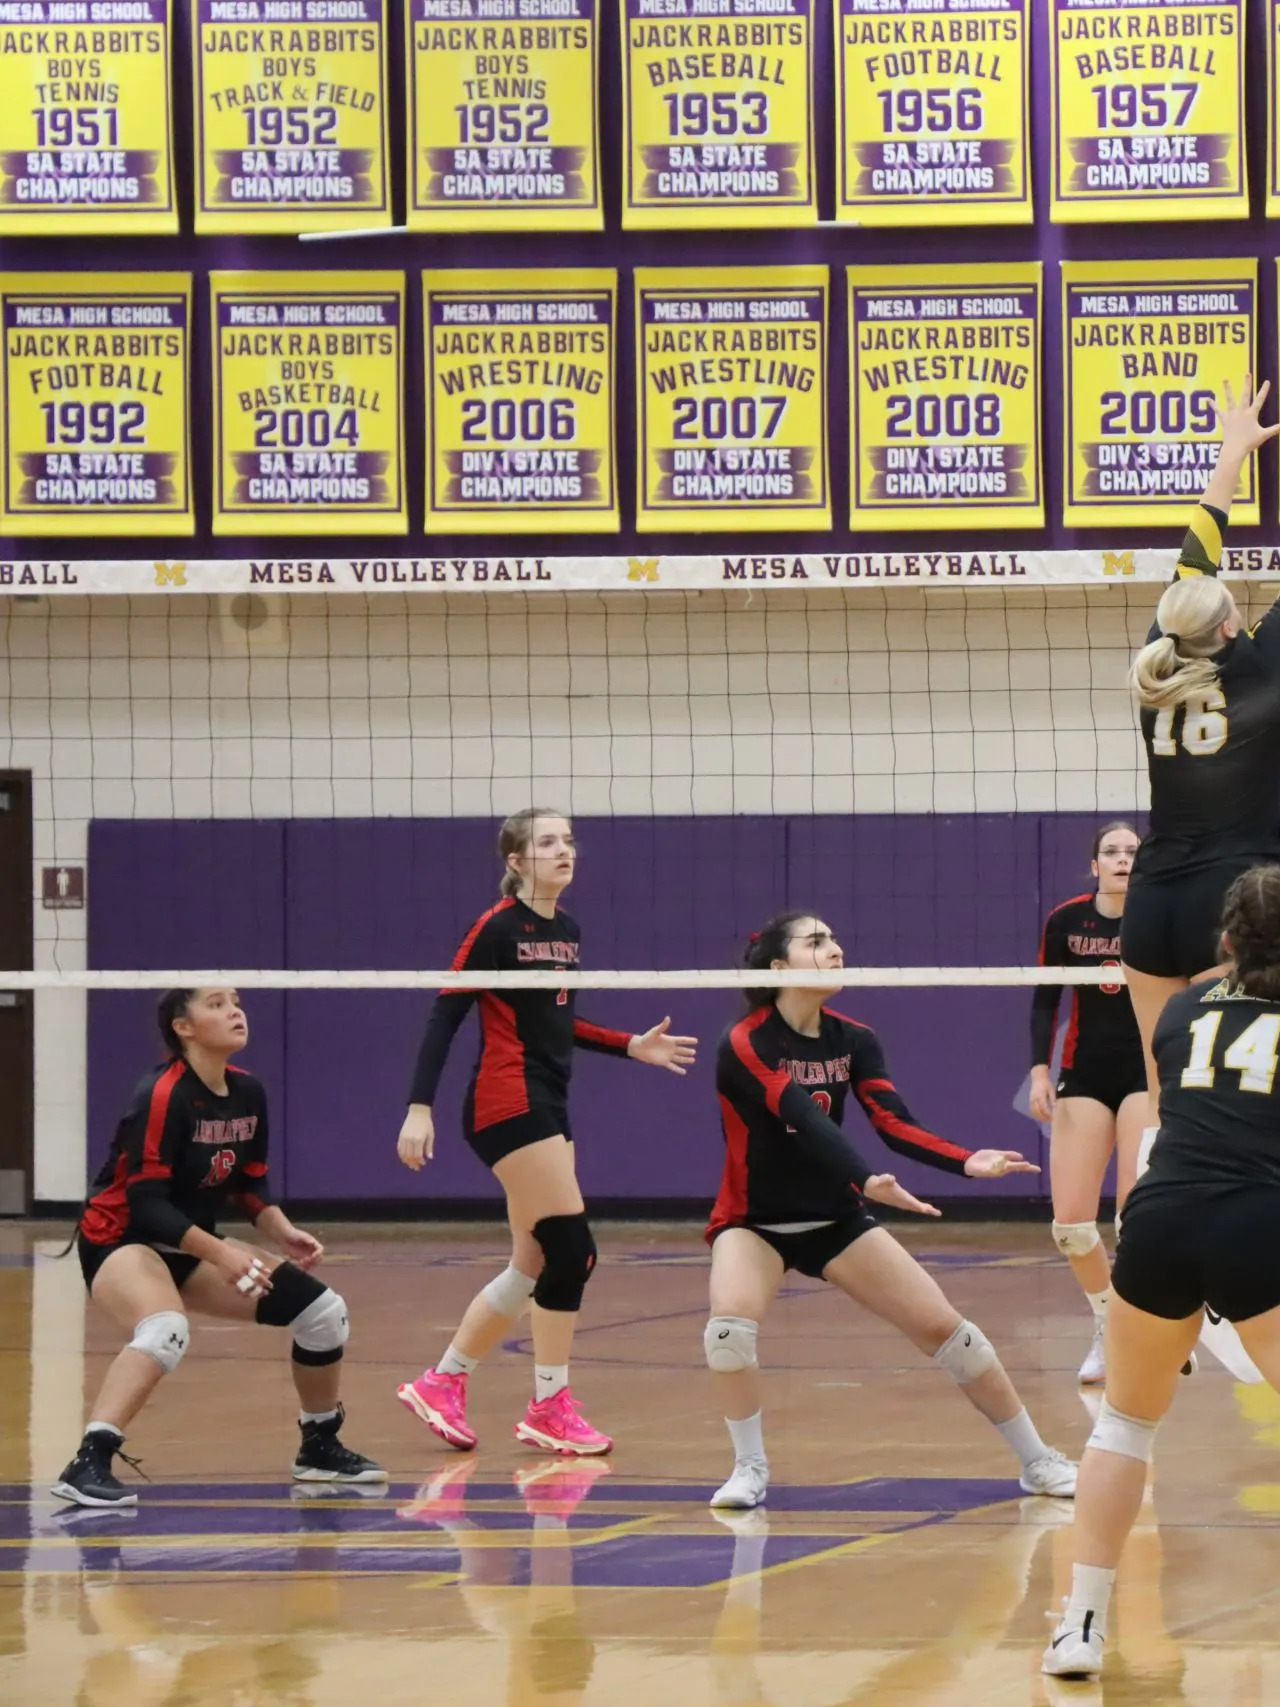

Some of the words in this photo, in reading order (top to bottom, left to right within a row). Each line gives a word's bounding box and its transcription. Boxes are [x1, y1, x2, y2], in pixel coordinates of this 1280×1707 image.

[633, 24, 801, 47] JACKRABBITS
[847, 20, 1016, 44] JACKRABBITS
[1061, 12, 1233, 40] JACKRABBITS
[5, 32, 159, 53] ACKRABBITS
[206, 30, 374, 52] JACKRABBITS
[418, 27, 587, 50] JACKRABBITS
[49, 61, 100, 77] BOYS
[264, 59, 315, 76] BOYS
[476, 56, 528, 74] BOYS
[648, 54, 784, 86] BASEBALL
[866, 50, 1000, 82] FOOTBALL
[1077, 45, 1215, 78] BASEBALL
[35, 83, 119, 104] TENNIS
[212, 83, 282, 112] TRACK
[292, 87, 309, 102] &
[314, 83, 374, 112] FIELD
[464, 78, 545, 99] TENNIS
[664, 92, 767, 135] 1953
[878, 89, 981, 132] 1956
[1092, 83, 1197, 128] 1957
[32, 108, 117, 146] 1951
[243, 107, 336, 145] 1952
[456, 104, 548, 143] 1952
[28, 153, 54, 173] 5A
[60, 152, 125, 172] STATE
[243, 152, 268, 171] 5A
[272, 152, 339, 171] STATE
[455, 150, 480, 169] 5A
[487, 149, 551, 168] STATE
[884, 144, 909, 164] 5A
[915, 141, 981, 163] STATE
[17, 178, 138, 199] CHAMPIONS
[232, 177, 352, 197] CHAMPIONS
[444, 175, 564, 195] CHAMPIONS
[873, 168, 993, 190] CHAMPIONS
[18, 309, 63, 323] MESA
[71, 309, 106, 322] HIGH
[113, 308, 170, 323] SCHOOL
[444, 305, 489, 320] MESA
[497, 305, 531, 320] HIGH
[538, 304, 596, 319] SCHOOL
[224, 334, 392, 356] JACKRABBITS
[436, 331, 604, 354] JACKRABBITS
[648, 329, 816, 352] JACKRABBITS
[861, 326, 1029, 350] JACKRABBITS
[1075, 322, 1245, 346] JACKRABBITS
[10, 335, 179, 357] JACKRABBITS
[282, 361, 333, 380] BOYS
[651, 358, 815, 393] WRESTLING
[864, 356, 1028, 391] WRESTLING
[1123, 352, 1197, 378] BAND
[30, 364, 162, 395] FOOTBALL
[440, 360, 603, 395] WRESTLING
[239, 383, 379, 412] BASKETBALL
[40, 402, 144, 443] 1992
[462, 399, 574, 441] 2006
[673, 396, 786, 439] 2007
[887, 394, 999, 437] 2008
[1101, 390, 1215, 434] 2009
[255, 409, 359, 447] 2004
[47, 455, 72, 473] 5A
[80, 453, 142, 473] STATE
[261, 454, 285, 472] 5A
[292, 453, 356, 472] STATE
[463, 452, 493, 471] DIV
[502, 452, 508, 471] 1
[515, 450, 578, 470] STATE
[675, 451, 705, 470] DIV
[713, 450, 720, 469] 1
[725, 449, 790, 469] STATE
[888, 448, 918, 468] DIV
[927, 448, 933, 468] 1
[940, 445, 1003, 467] STATE
[1099, 445, 1130, 465] DIV
[1138, 444, 1149, 464] 3
[1156, 442, 1220, 464] STATE
[37, 480, 155, 499] CHAMPIONS
[250, 479, 368, 498] CHAMPIONS
[462, 477, 580, 496] CHAMPIONS
[674, 475, 792, 495] CHAMPIONS
[887, 472, 1006, 493] CHAMPIONS
[1100, 469, 1214, 491] CHAMPION
[250, 563, 335, 583] MESA
[350, 560, 551, 582] VOLLEYBALL
[723, 558, 808, 579] MESA
[824, 555, 1025, 577] VOLLEYBALL
[1152, 690, 1229, 756] 16
